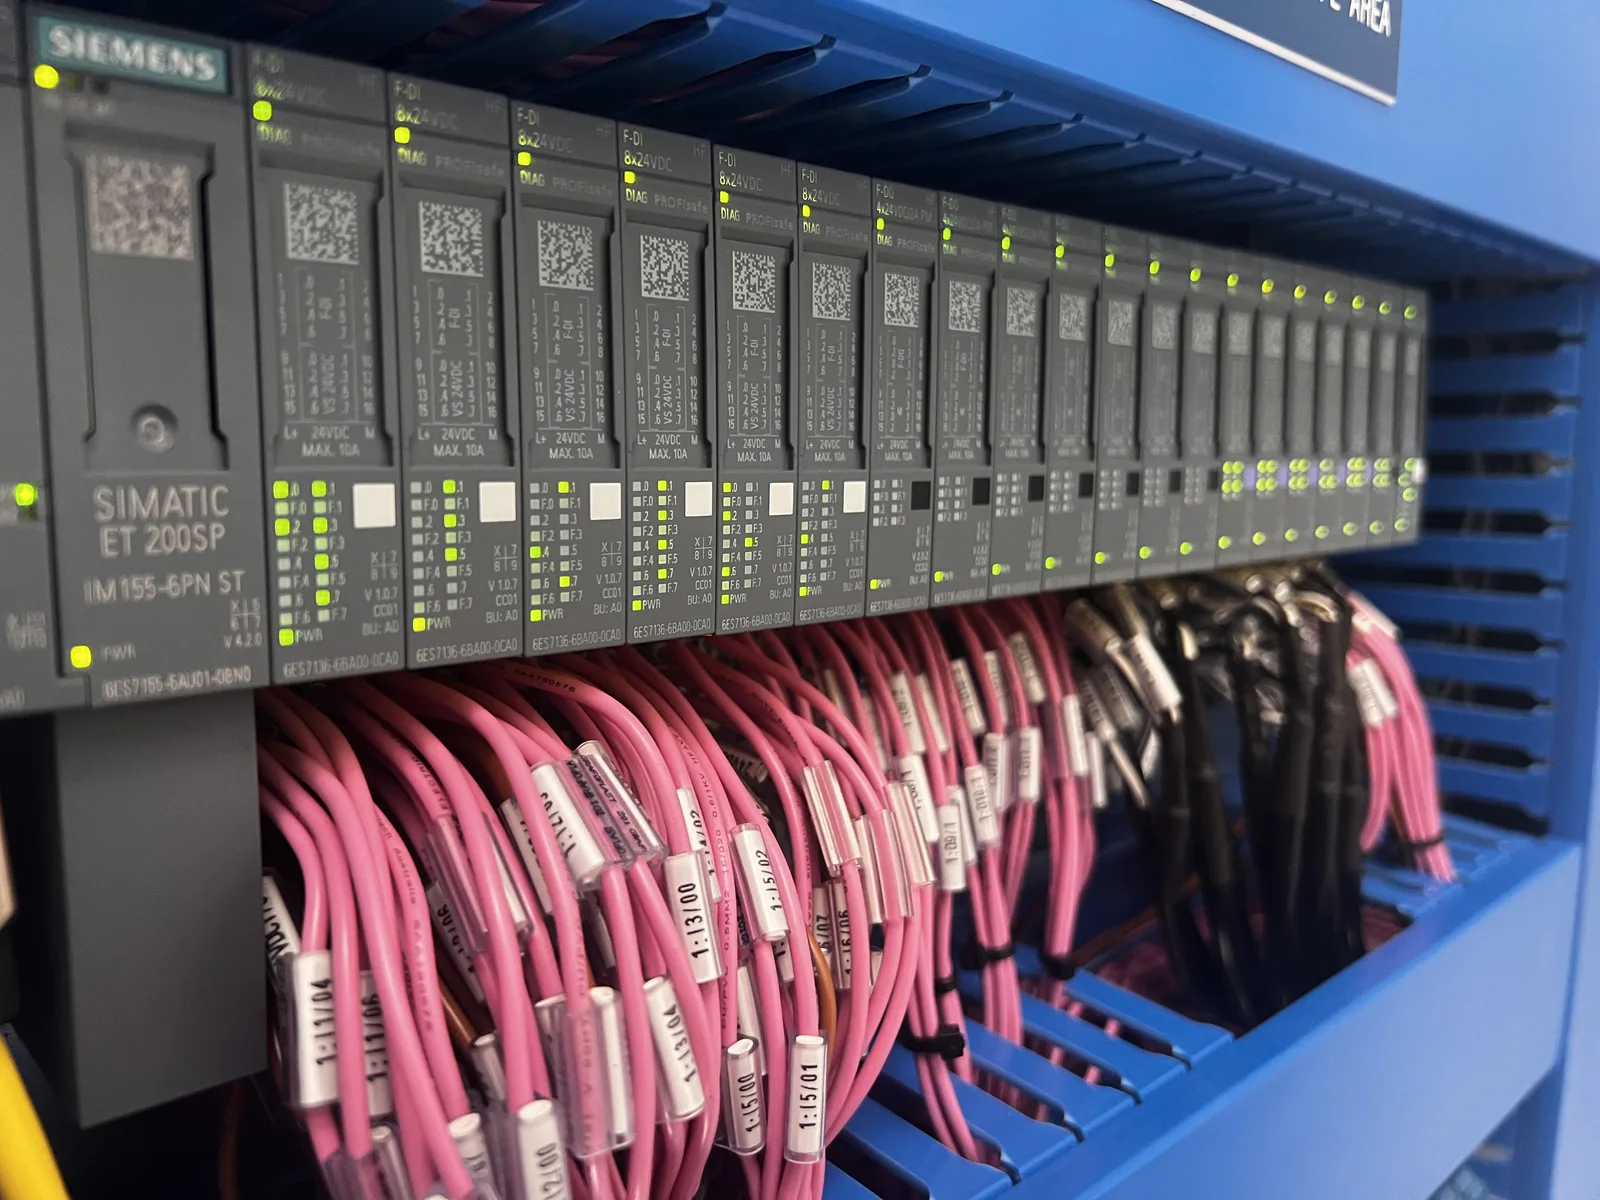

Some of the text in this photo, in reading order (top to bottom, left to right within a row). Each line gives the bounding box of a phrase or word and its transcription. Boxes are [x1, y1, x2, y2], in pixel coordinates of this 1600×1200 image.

[49, 24, 217, 81] SIEMENS
[517, 108, 540, 126] F-DI
[518, 129, 573, 154] 8x24VDC
[624, 129, 643, 146] F-DI
[398, 147, 427, 166] DIAG
[624, 150, 673, 172] 8x24VDC
[719, 151, 736, 167] F-DI
[520, 170, 545, 187] DIAG
[720, 171, 762, 191] 8x24VDC
[802, 169, 818, 183] F-DI
[626, 188, 648, 204] DIAG
[802, 188, 840, 206] 8x24VDC
[721, 207, 740, 222] DIAG
[803, 222, 820, 235] DIAG
[877, 233, 892, 247] DIAG
[662, 329, 670, 347] F-DI
[565, 369, 575, 422] VS 24VDC
[663, 376, 672, 424] VS 24VDC
[751, 416, 758, 429] VS
[442, 428, 475, 440] 24VDC
[556, 433, 586, 444] 24VDC
[598, 433, 605, 444] M
[655, 434, 681, 445] 24VDC
[692, 435, 698, 445] M
[743, 439, 766, 448] 24VDC
[775, 439, 780, 448] M
[466, 444, 484, 456] 10A
[549, 448, 593, 459] MAX. 10A
[650, 449, 687, 459] MAX. 10A
[738, 452, 771, 462] MAX. 10A
[643, 481, 649, 492] .0
[668, 481, 673, 491] .1
[93, 485, 229, 522] SIMATIC
[643, 496, 653, 506] F.0
[668, 496, 677, 505] F.1
[643, 511, 649, 521] .2
[668, 510, 674, 520] .3
[643, 526, 653, 536] F.2
[668, 525, 678, 535] F.3
[102, 523, 226, 559] ET 200SP
[643, 541, 649, 551] .4
[668, 540, 674, 549] .5
[695, 537, 700, 546] X
[643, 556, 654, 565] F.4
[668, 554, 678, 564] F.5
[668, 568, 674, 578] .7
[690, 566, 712, 577] V 1.0.7
[772, 562, 792, 573] V 1.0.7
[218, 570, 245, 593] ST
[596, 573, 622, 585] V 1.0.7
[643, 571, 649, 580] .6
[777, 575, 792, 585] CC01
[643, 585, 653, 595] F.6
[668, 583, 678, 593] F.7
[695, 580, 712, 590] CC01
[603, 588, 622, 599] CC01
[688, 593, 712, 605] BU: A0
[730, 594, 746, 604] PWR
[783, 588, 791, 598] A0
[594, 601, 622, 615] BU: A0
[643, 599, 661, 611] PWR
[543, 608, 563, 621] PWR
[427, 617, 451, 630] PWR
[722, 612, 790, 630] 6ES7136-6BA00-0CA0
[634, 618, 711, 638] 6ES7136-6BA00-0CA0
[224, 636, 232, 649] V
[533, 629, 621, 651] 6ES7136-6BA00-0CA0
[673, 730, 698, 764] HEAVY
[756, 850, 782, 911] 1:15/02
[678, 882, 709, 959] 1:13/00
[663, 1004, 697, 1083] 1:13/04
[799, 1064, 818, 1129] 1:15/01
[738, 1073, 760, 1133] 1:15/00
